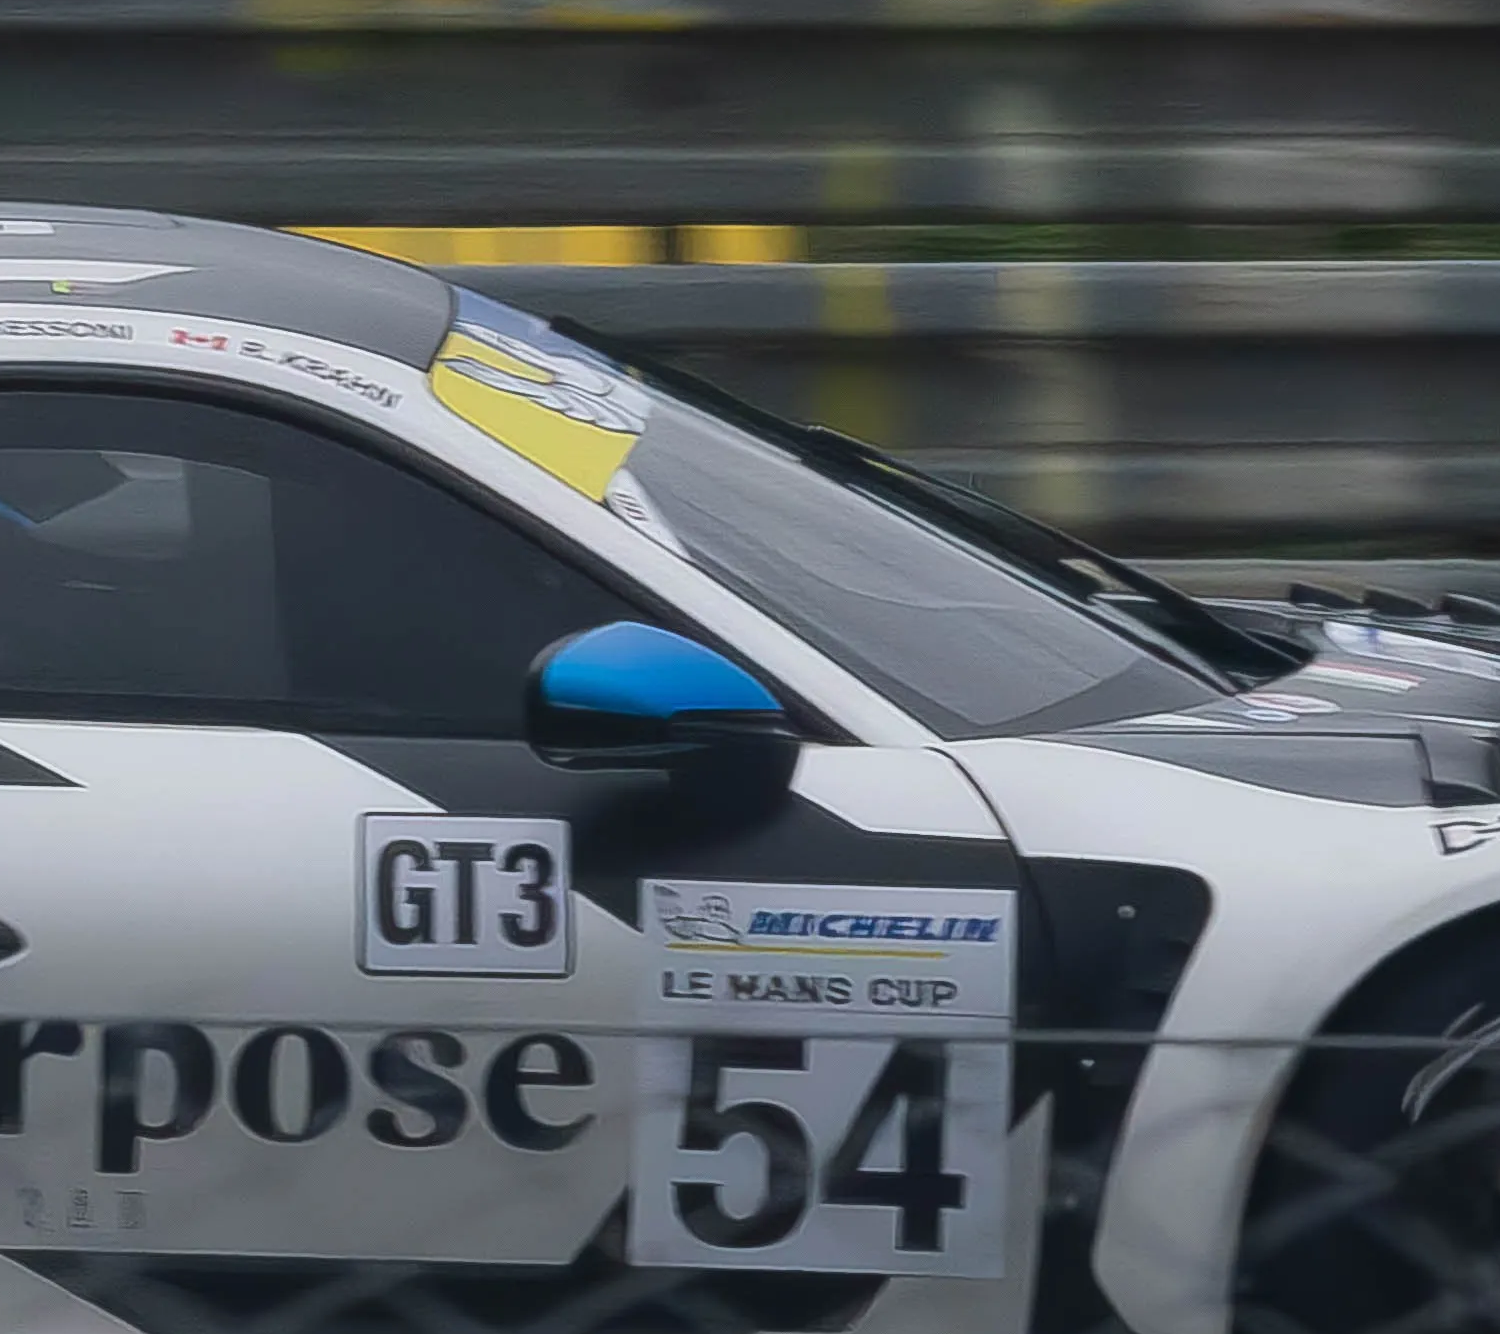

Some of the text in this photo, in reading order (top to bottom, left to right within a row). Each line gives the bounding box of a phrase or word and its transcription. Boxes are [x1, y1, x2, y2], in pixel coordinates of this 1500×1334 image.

[377, 840, 557, 948] GT3
[746, 909, 1001, 944] MICHELIN
[663, 970, 960, 1008] LE MANS CUP
[668, 1035, 969, 1254] 54
